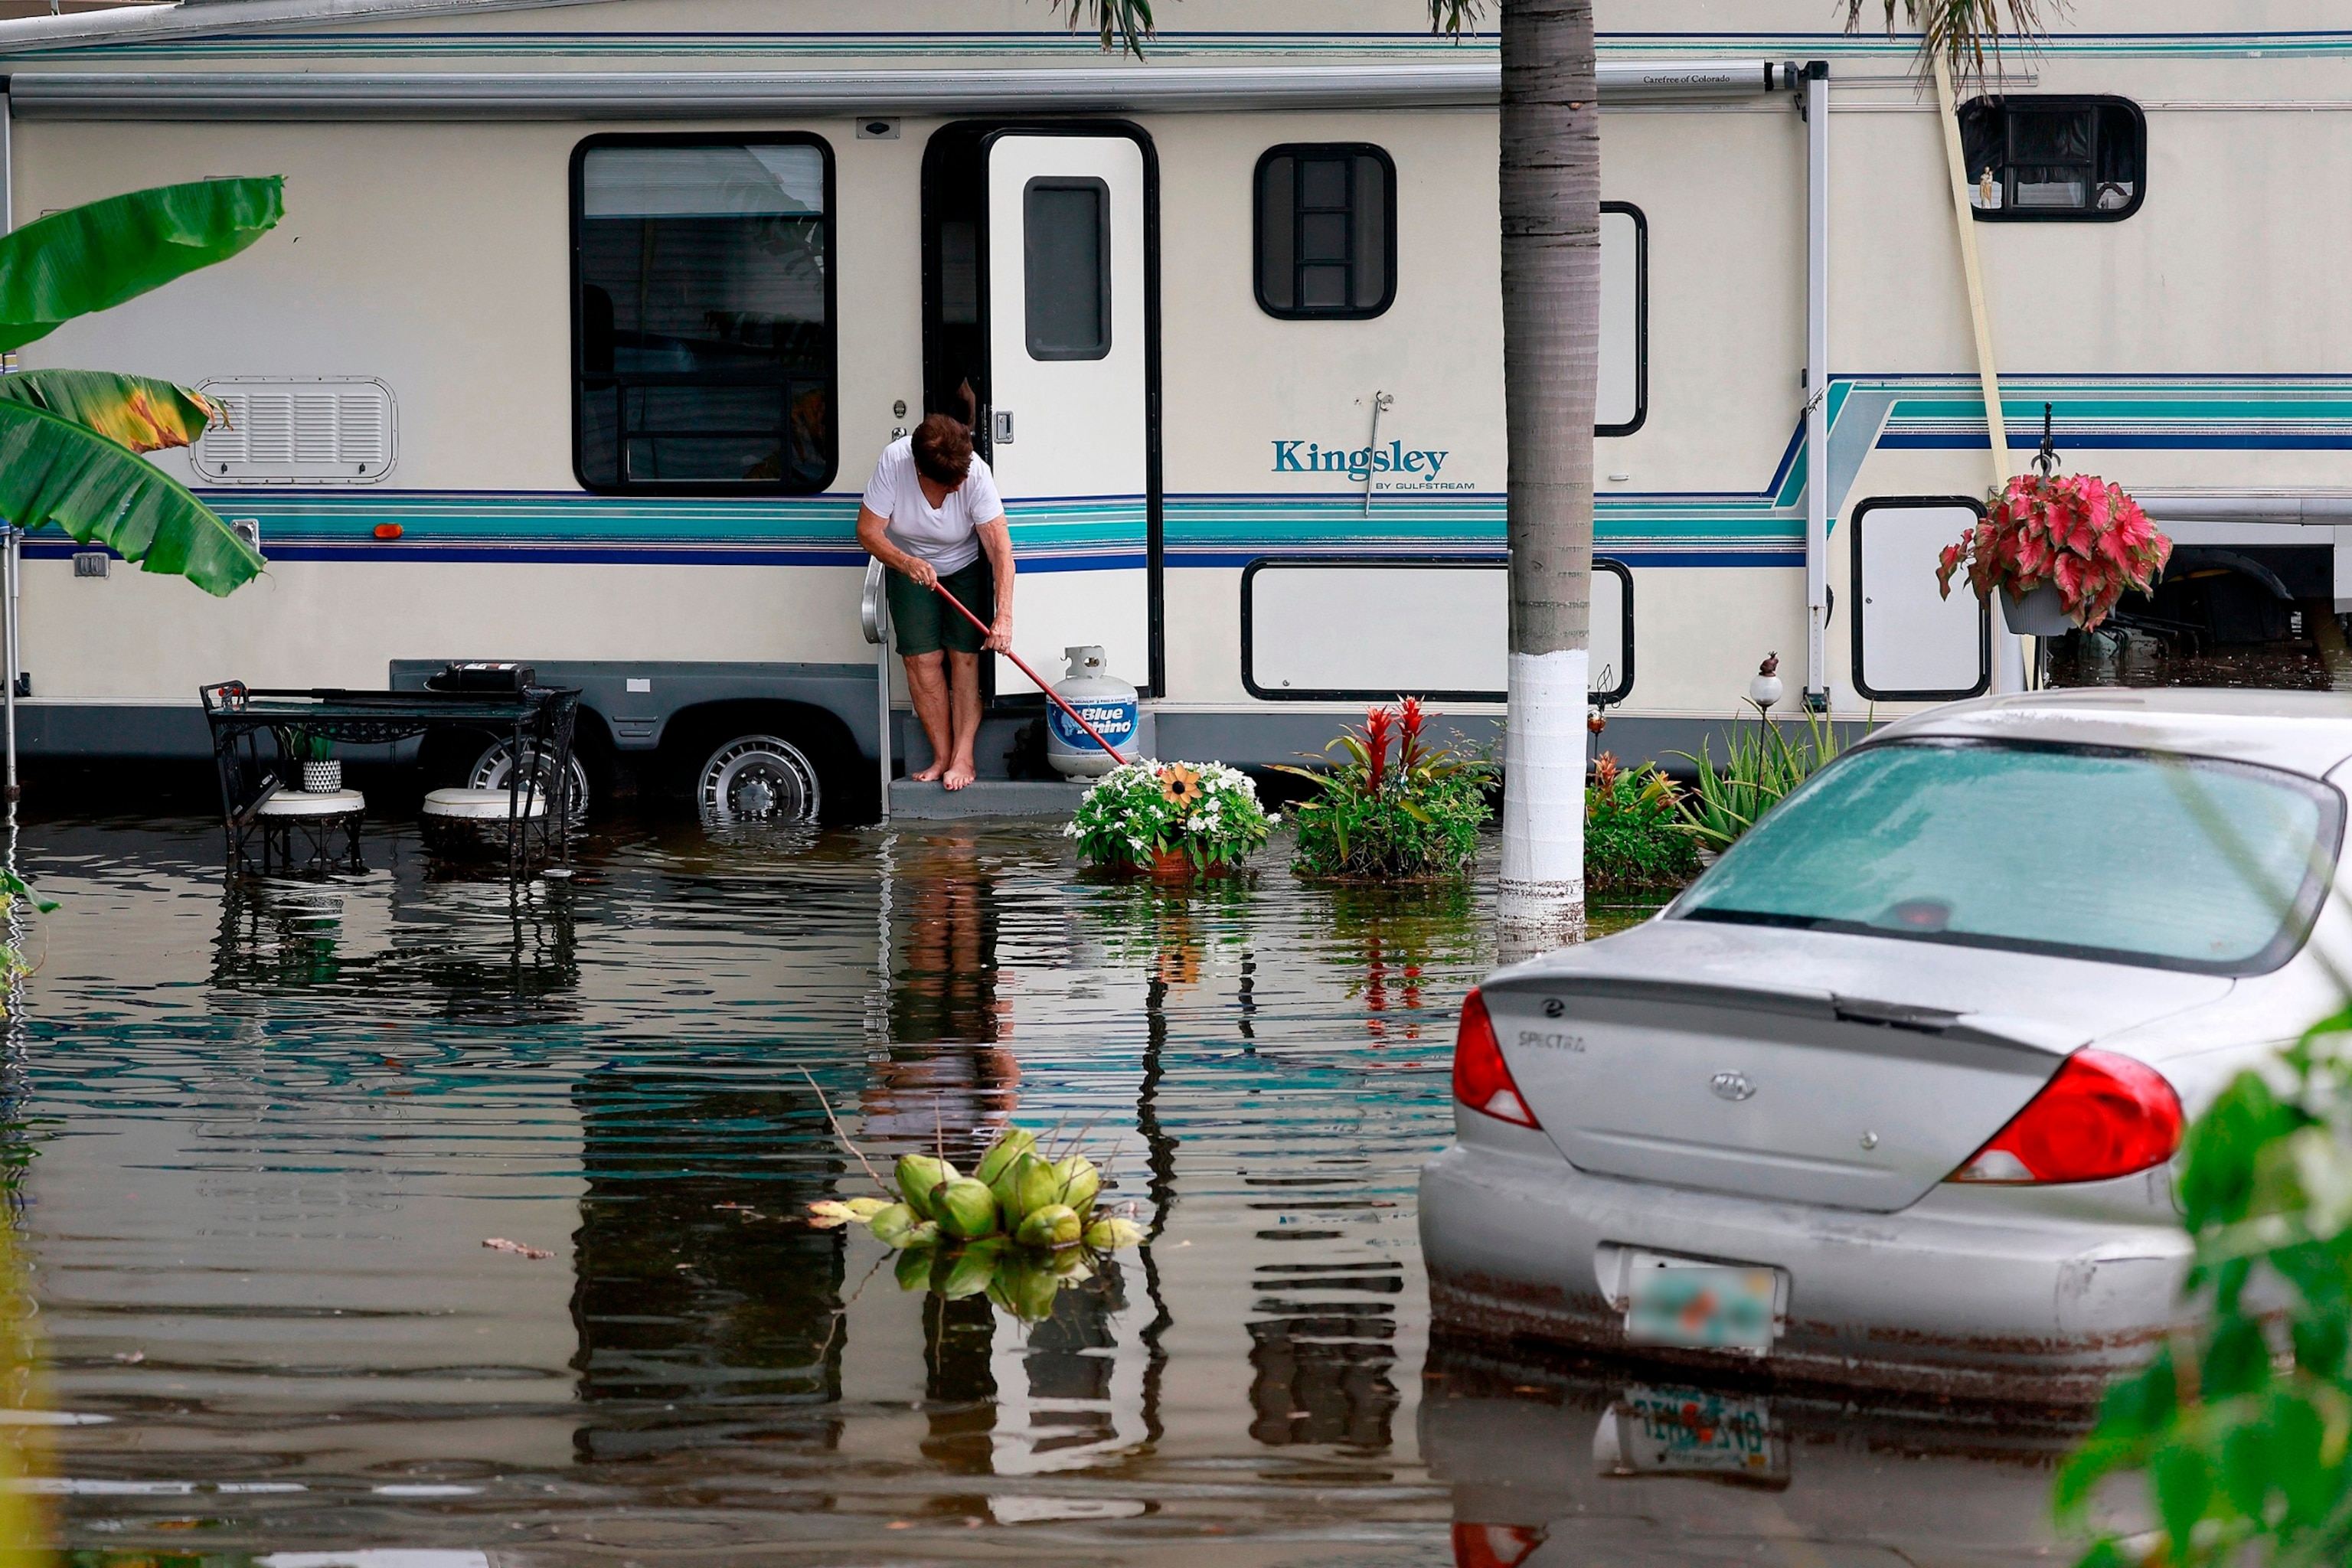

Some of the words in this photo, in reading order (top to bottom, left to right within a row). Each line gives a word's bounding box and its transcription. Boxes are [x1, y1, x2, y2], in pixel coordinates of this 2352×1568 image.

[1643, 75, 1679, 83] Carefree
[1681, 75, 1690, 83] of
[1272, 440, 1449, 482] Kingsley
[1082, 707, 1123, 720] Blue
